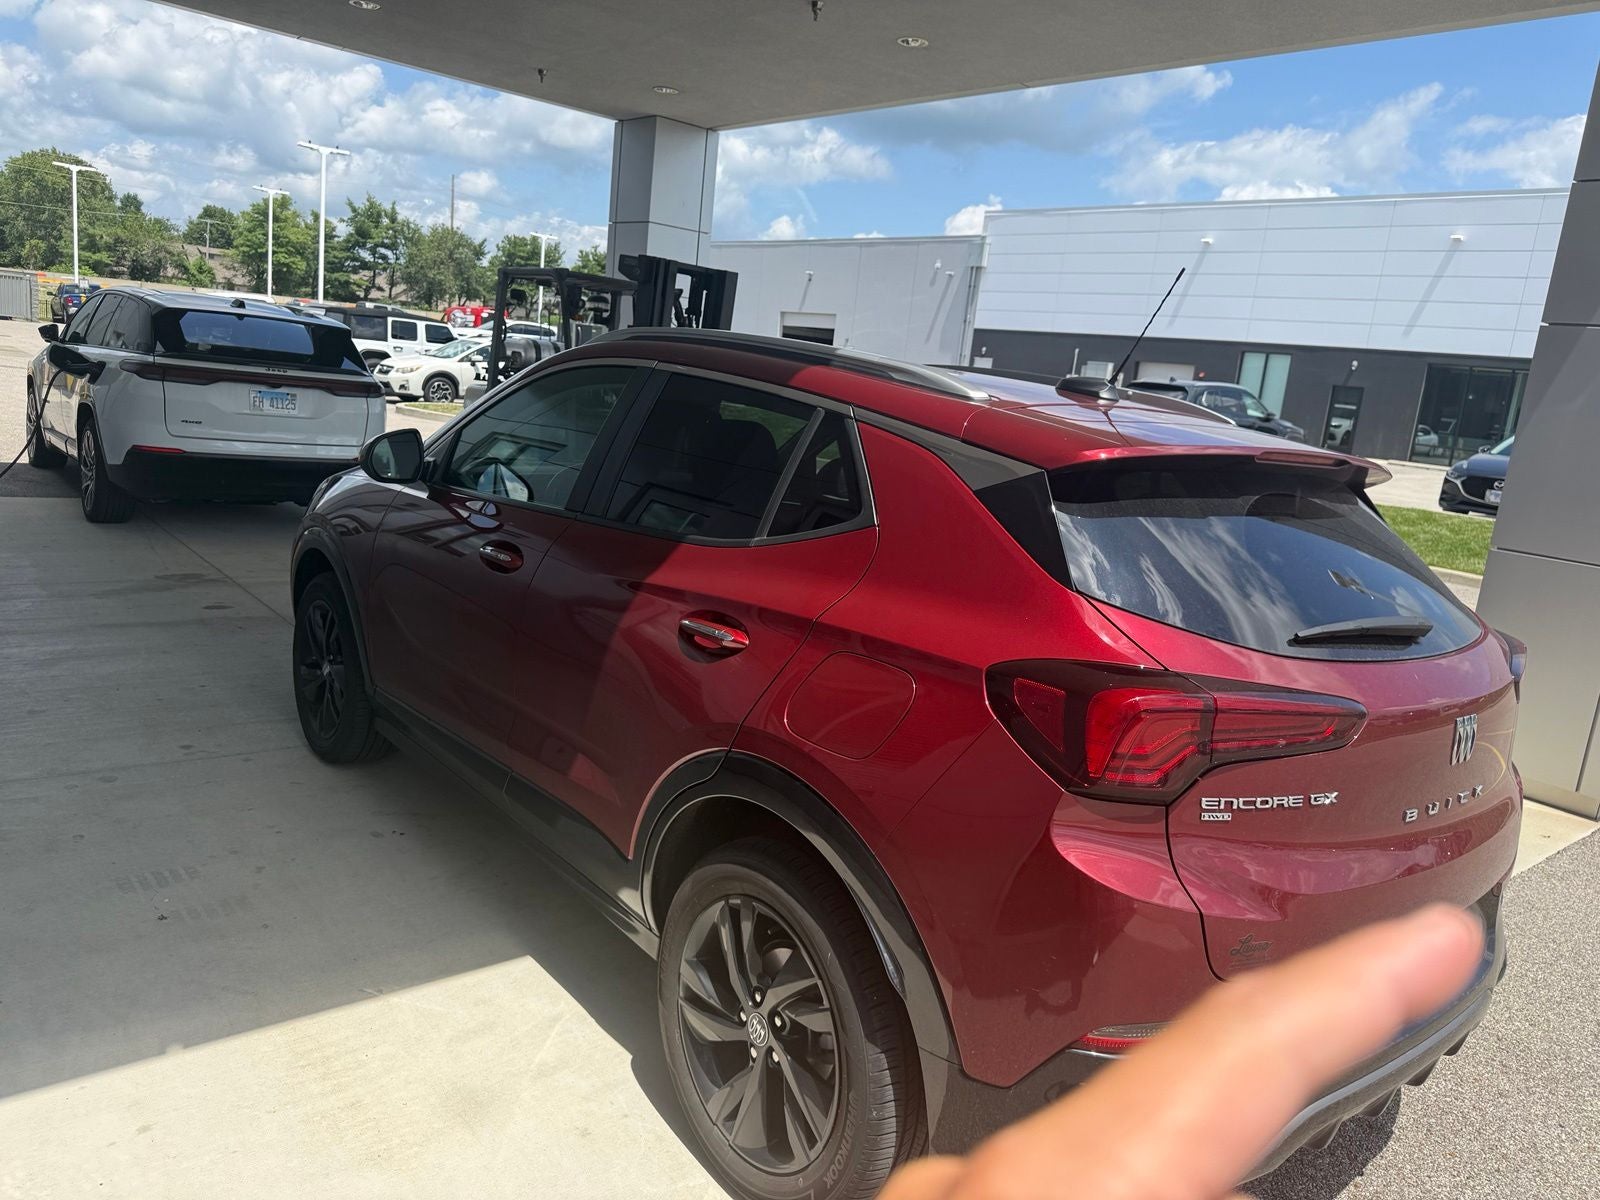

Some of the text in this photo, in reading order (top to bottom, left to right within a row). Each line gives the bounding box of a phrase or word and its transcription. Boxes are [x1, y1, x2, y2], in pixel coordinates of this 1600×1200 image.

[269, 397, 297, 411] 41125
[1200, 792, 1339, 810] ENCORE GX
[1402, 784, 1484, 823] BUICK
[1201, 812, 1232, 821] AWD
